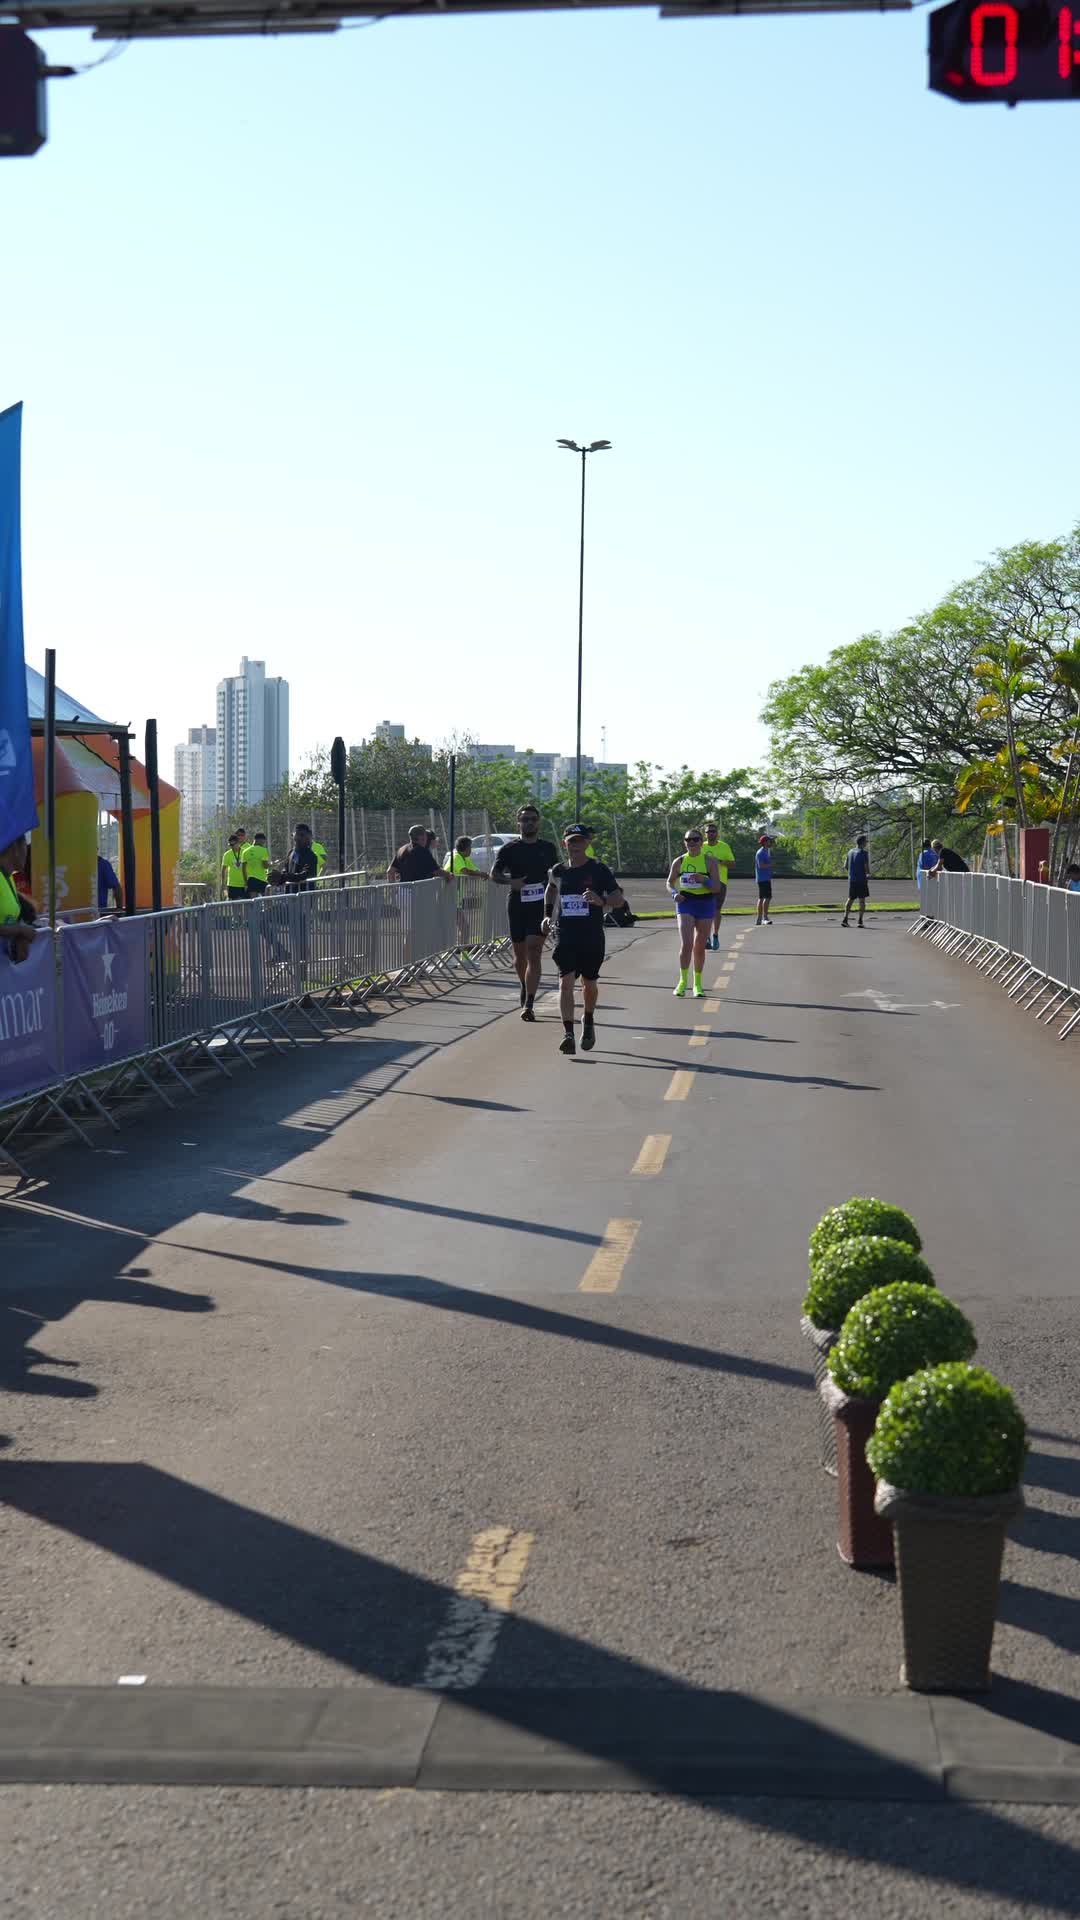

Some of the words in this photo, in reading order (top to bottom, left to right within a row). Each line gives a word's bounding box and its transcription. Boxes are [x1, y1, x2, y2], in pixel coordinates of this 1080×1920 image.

[566, 901, 584, 910] 409
[0, 987, 44, 1041] mar
[91, 987, 128, 1018] Heineken
